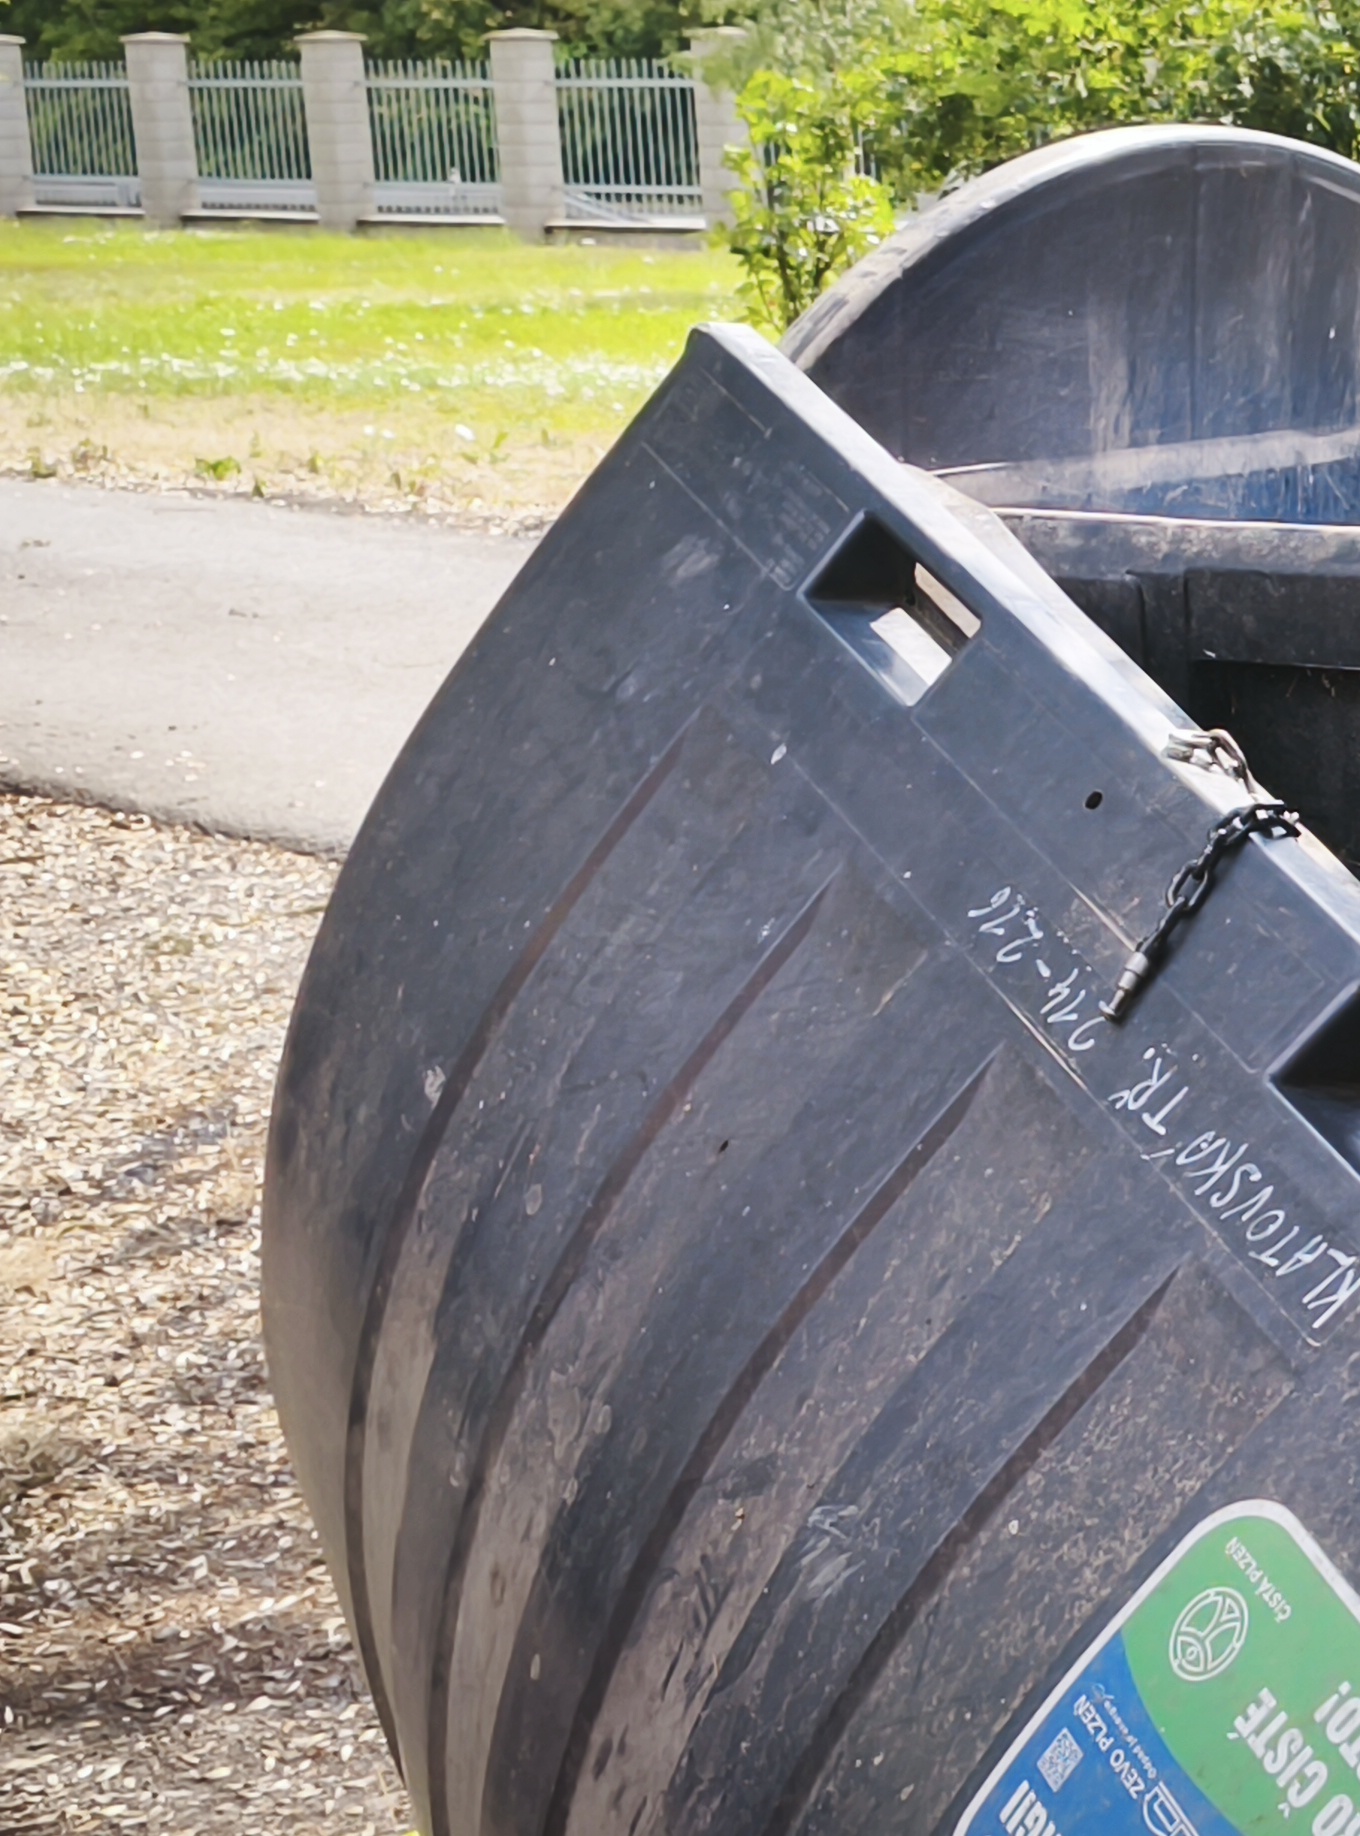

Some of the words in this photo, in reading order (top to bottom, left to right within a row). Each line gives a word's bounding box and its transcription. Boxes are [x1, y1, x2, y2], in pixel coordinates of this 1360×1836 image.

[1108, 1046, 1189, 1136] TŘ.
[1224, 1536, 1264, 1584] PLZEŇ
[1254, 1576, 1292, 1624] ČISTÁ
[1073, 1694, 1115, 1753] PLZEŇ
[1109, 1748, 1146, 1800] ZEVO
[1132, 1745, 1157, 1779] Odpad
[1226, 1686, 1329, 1819] ČISTÉ
[999, 1779, 1062, 1836] GII
